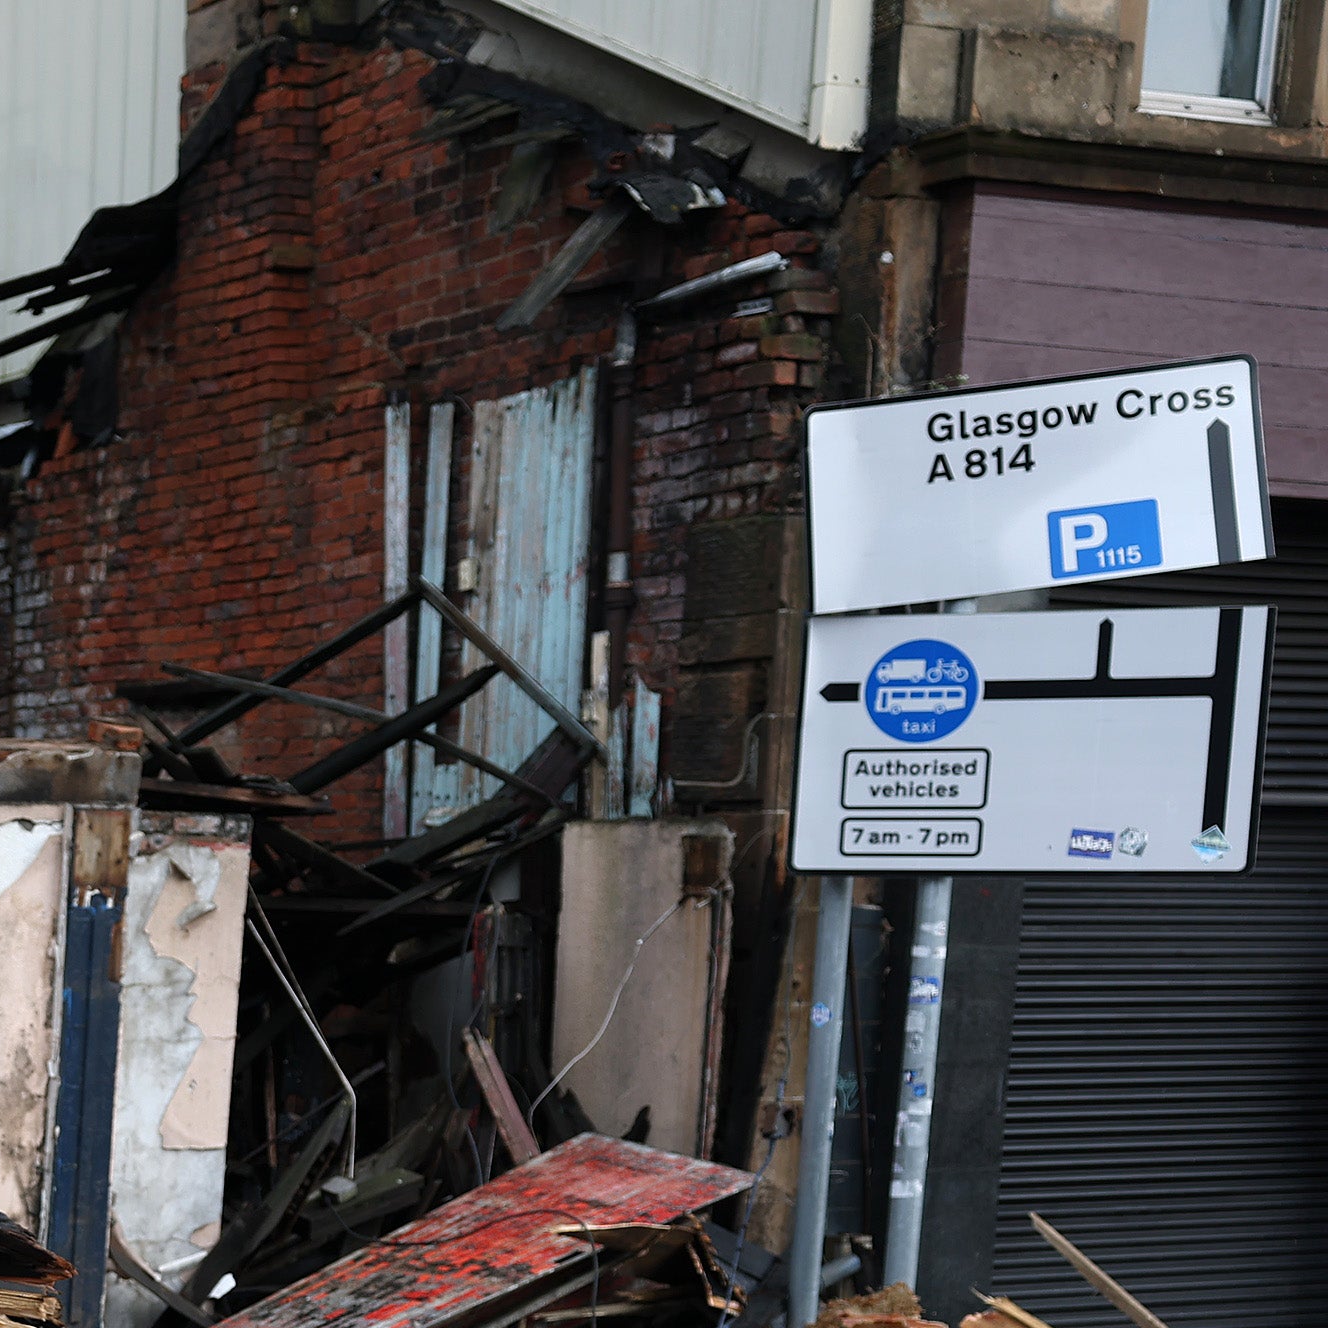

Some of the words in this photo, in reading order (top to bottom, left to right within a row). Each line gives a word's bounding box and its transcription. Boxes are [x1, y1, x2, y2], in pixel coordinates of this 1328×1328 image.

[927, 402, 1098, 443] Glasgow
[1116, 385, 1234, 420] Cross
[1059, 513, 1108, 573] P
[1097, 544, 1142, 568] 1115
[903, 719, 936, 734] taxi
[854, 759, 978, 776] Authorised
[869, 781, 959, 797] vehicles
